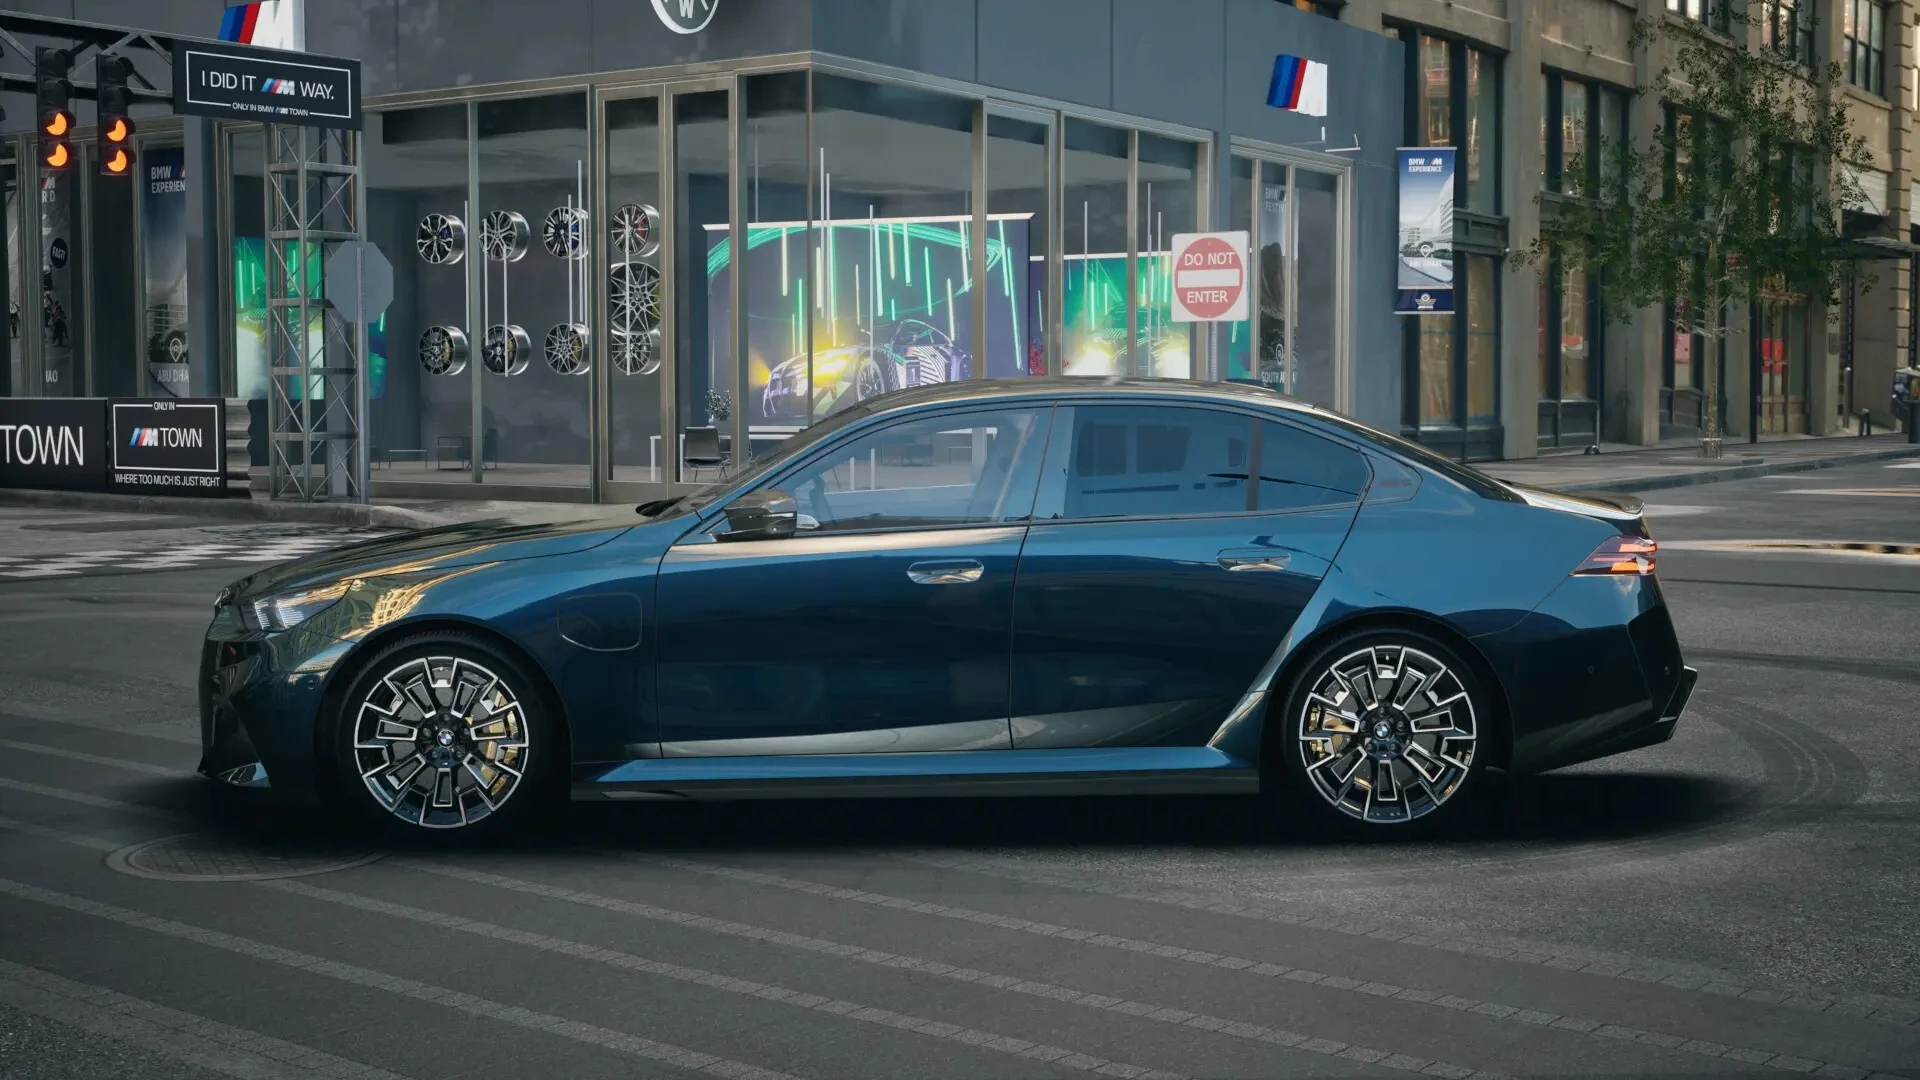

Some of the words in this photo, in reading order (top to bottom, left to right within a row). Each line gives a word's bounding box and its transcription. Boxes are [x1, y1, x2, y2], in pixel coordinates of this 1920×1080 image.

[201, 70, 206, 87] I
[210, 71, 238, 90] DID
[242, 75, 257, 92] IT
[300, 81, 335, 100] WAY.
[232, 102, 250, 111] ONLY
[250, 103, 257, 112] IN
[257, 104, 274, 113] BMW
[289, 108, 309, 117] TOWN
[1408, 157, 1425, 165] BMW
[151, 165, 172, 180] BMW
[151, 180, 186, 194] EXPERIEN
[1184, 252, 1204, 266] DO
[1207, 251, 1235, 265] NOT
[1187, 290, 1229, 304] ENTER
[153, 401, 168, 411] ONLY
[168, 401, 175, 411] IN
[0, 424, 84, 466] TOWN
[160, 427, 202, 448] TOWN
[114, 473, 138, 484] WHERE
[138, 474, 153, 485] TOO
[153, 474, 174, 486] MUCH
[174, 475, 181, 486] IS
[181, 475, 200, 487] JUST
[200, 476, 221, 488] RIGHT
